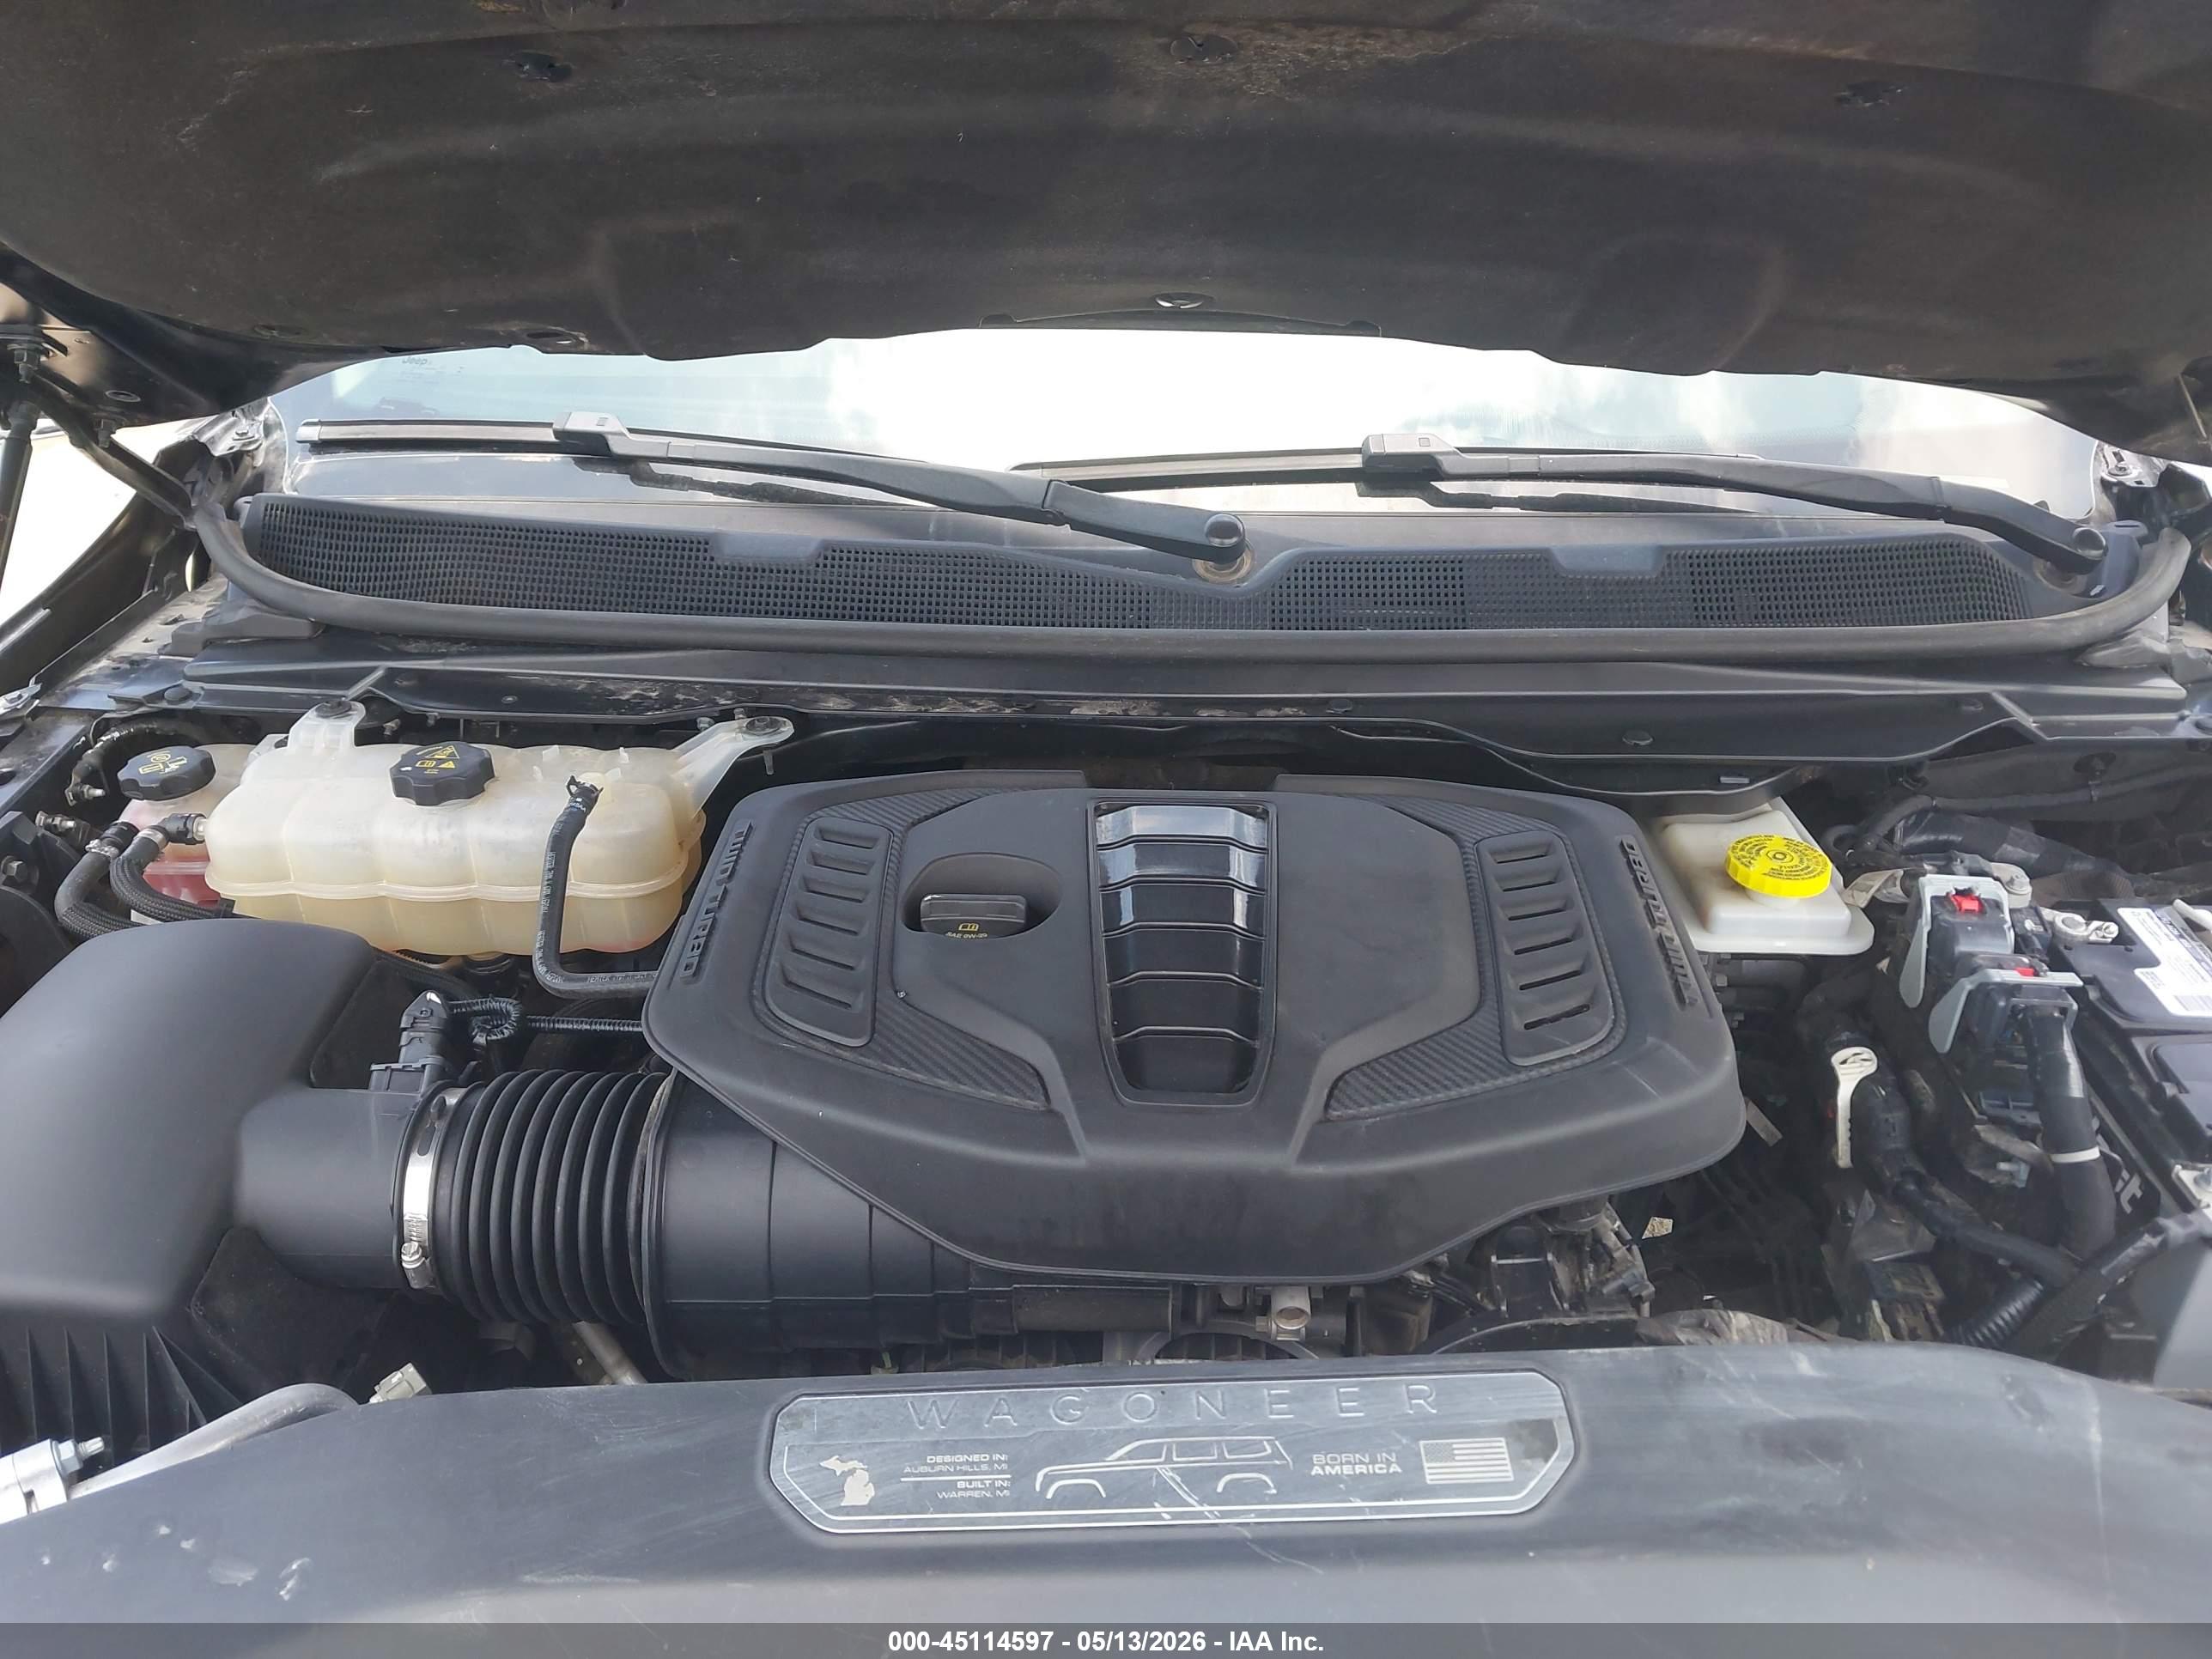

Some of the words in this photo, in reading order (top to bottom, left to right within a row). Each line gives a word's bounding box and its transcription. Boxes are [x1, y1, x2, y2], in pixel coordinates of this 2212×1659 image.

[907, 1384, 1437, 1431] WAGONEER
[927, 1455, 990, 1463] DESIGNED
[1312, 1453, 1370, 1464] BORN
[1377, 1451, 1397, 1462] IN
[1310, 1462, 1403, 1476] AMERICA
[957, 1480, 993, 1489] BUILT
